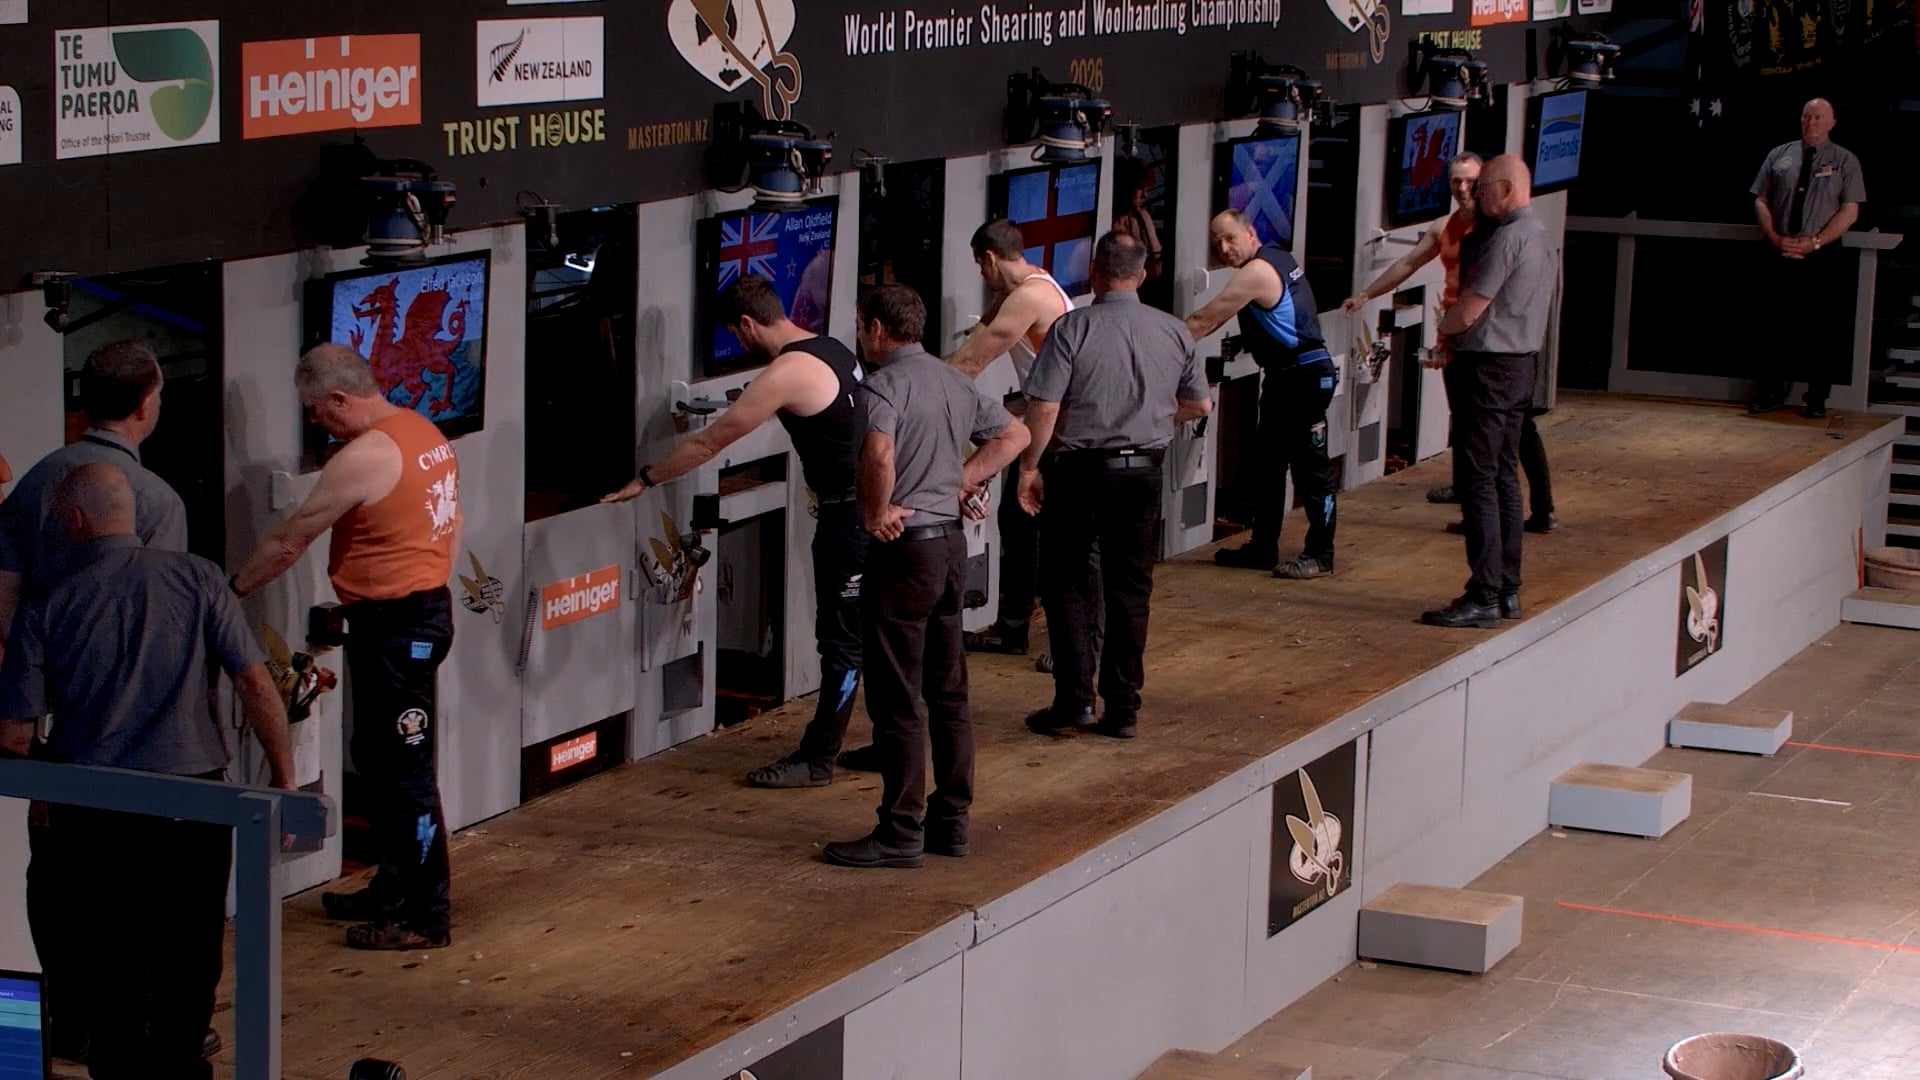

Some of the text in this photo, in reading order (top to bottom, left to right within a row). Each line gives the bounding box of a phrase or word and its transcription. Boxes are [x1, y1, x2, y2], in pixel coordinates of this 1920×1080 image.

[844, 0, 1281, 56] World Premier Shearing and Woolhandling Championship
[60, 35, 83, 60] TE
[60, 62, 116, 89] TUMU
[250, 36, 417, 122] Heiniger
[514, 60, 592, 81] NEW ZEALAND
[1070, 57, 1104, 93] 2026
[61, 89, 140, 119] PAEROA
[61, 137, 81, 149] Office
[82, 136, 90, 147] of
[91, 136, 102, 146] the
[124, 131, 150, 143] Trustee
[443, 108, 606, 156] TRUST HOUSE
[628, 119, 709, 150] MASTERTON.NZ
[785, 211, 832, 232] Allan Oldfield
[546, 573, 620, 620] Heiniger
[552, 737, 597, 766] Heiniger
